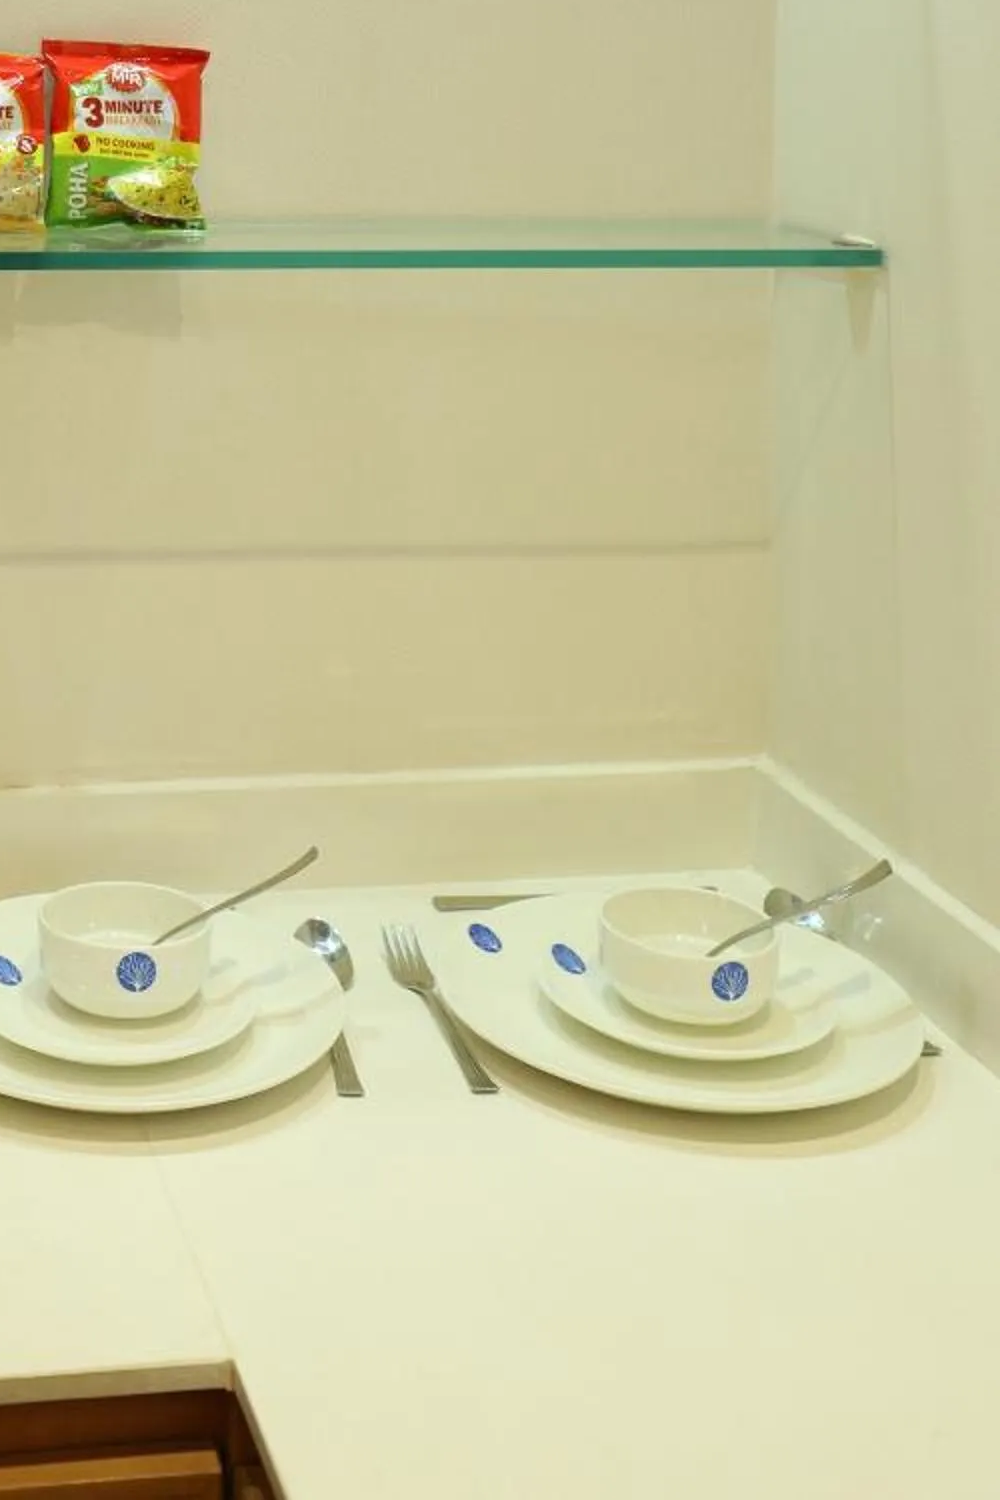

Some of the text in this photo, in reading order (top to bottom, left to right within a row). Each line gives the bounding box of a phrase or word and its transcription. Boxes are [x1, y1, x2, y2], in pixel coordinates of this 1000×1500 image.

[82, 96, 163, 128] 3 MINUTE
[68, 163, 89, 220] POHA
